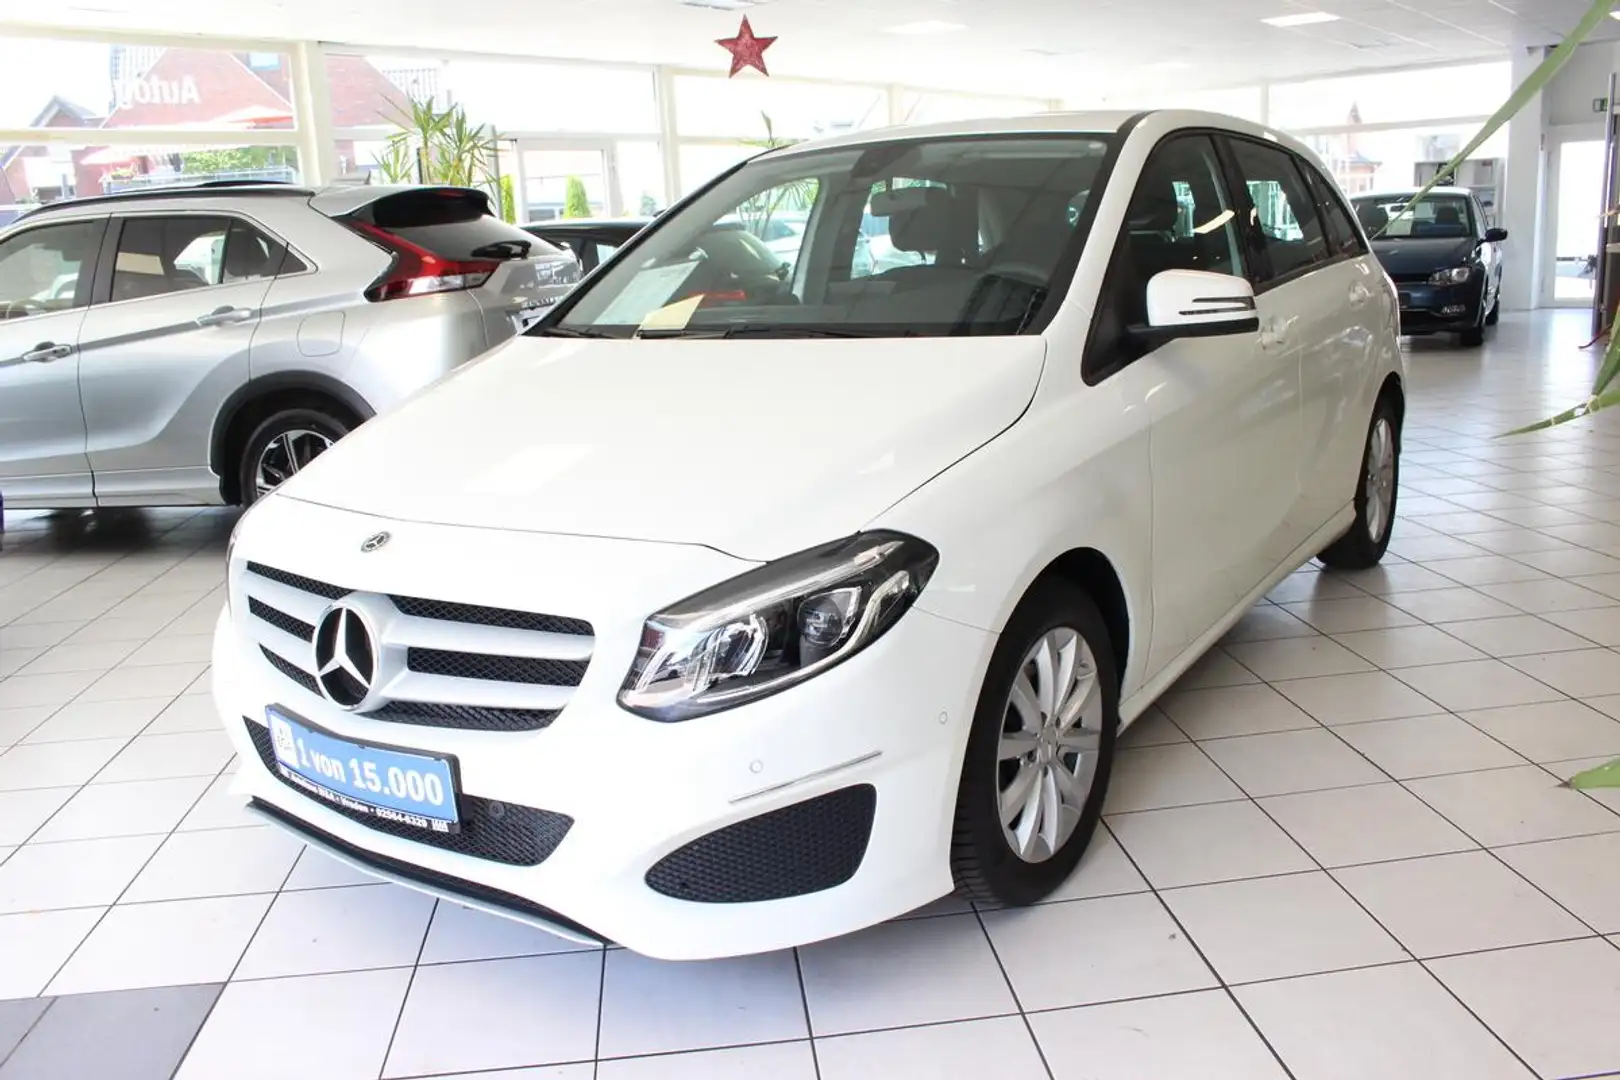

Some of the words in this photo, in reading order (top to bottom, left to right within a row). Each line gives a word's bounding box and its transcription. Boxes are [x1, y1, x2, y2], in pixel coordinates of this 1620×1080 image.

[296, 737, 310, 767] 1
[310, 750, 346, 784] von
[348, 758, 443, 806] 15.000
